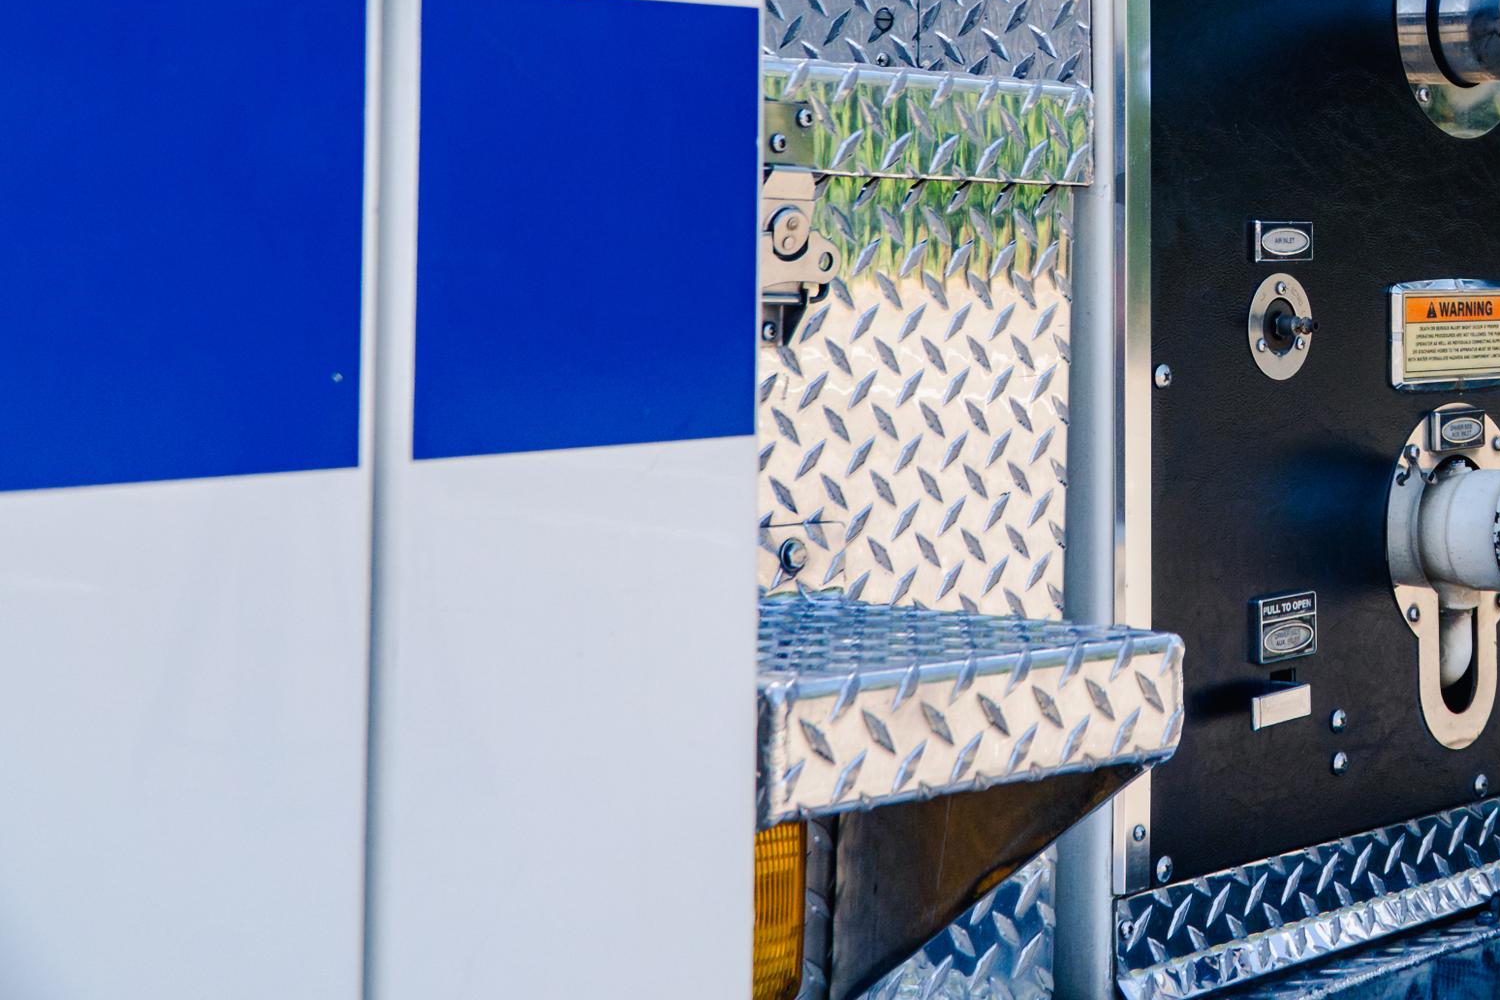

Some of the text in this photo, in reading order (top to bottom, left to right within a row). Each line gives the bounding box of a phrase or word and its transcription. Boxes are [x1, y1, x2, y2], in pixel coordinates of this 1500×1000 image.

[1439, 301, 1493, 317] WARNING
[1263, 599, 1312, 615] PULL TO OPEN
